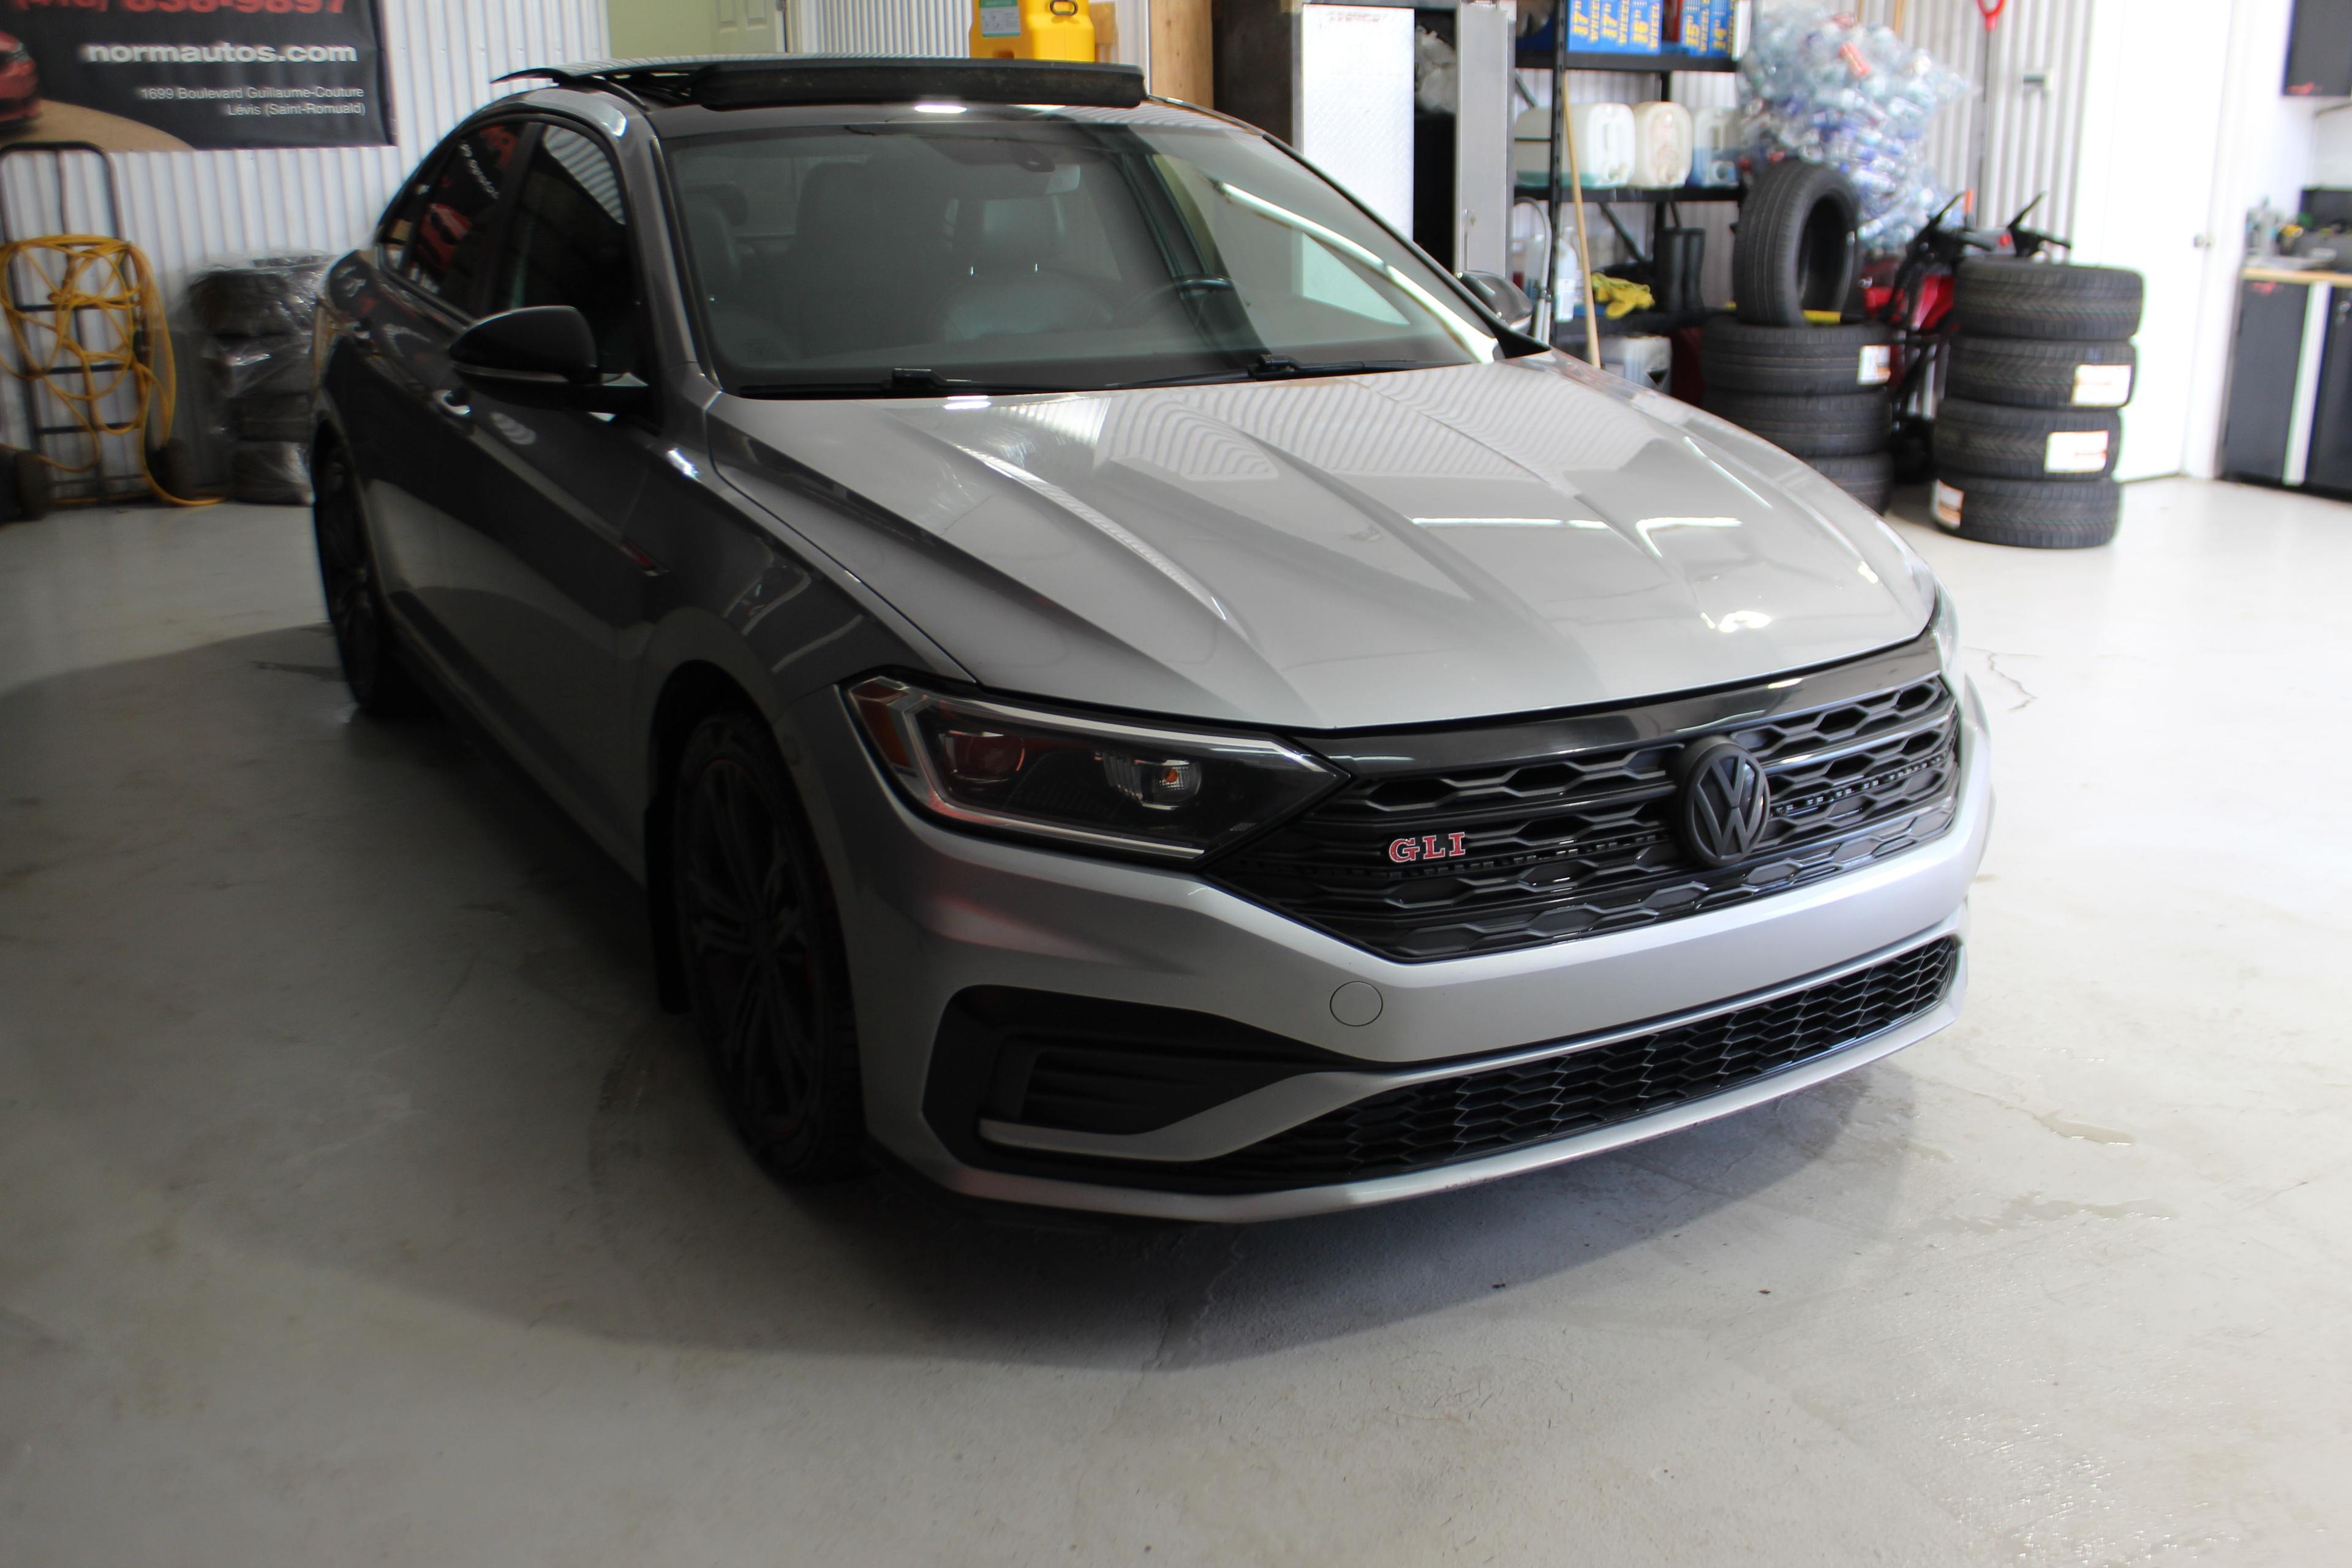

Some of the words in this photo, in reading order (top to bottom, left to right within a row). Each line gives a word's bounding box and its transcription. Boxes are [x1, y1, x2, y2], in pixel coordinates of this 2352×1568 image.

[1589, 0, 1600, 42] WHEE
[86, 42, 358, 62] normautos.com
[141, 88, 174, 99] 1699
[179, 87, 243, 99] Boulevard
[247, 86, 364, 99] Guillaume-Couture
[227, 103, 262, 116] Lévis
[265, 102, 366, 117] (Saint-Romuald)
[1389, 832, 1466, 863] GLI
